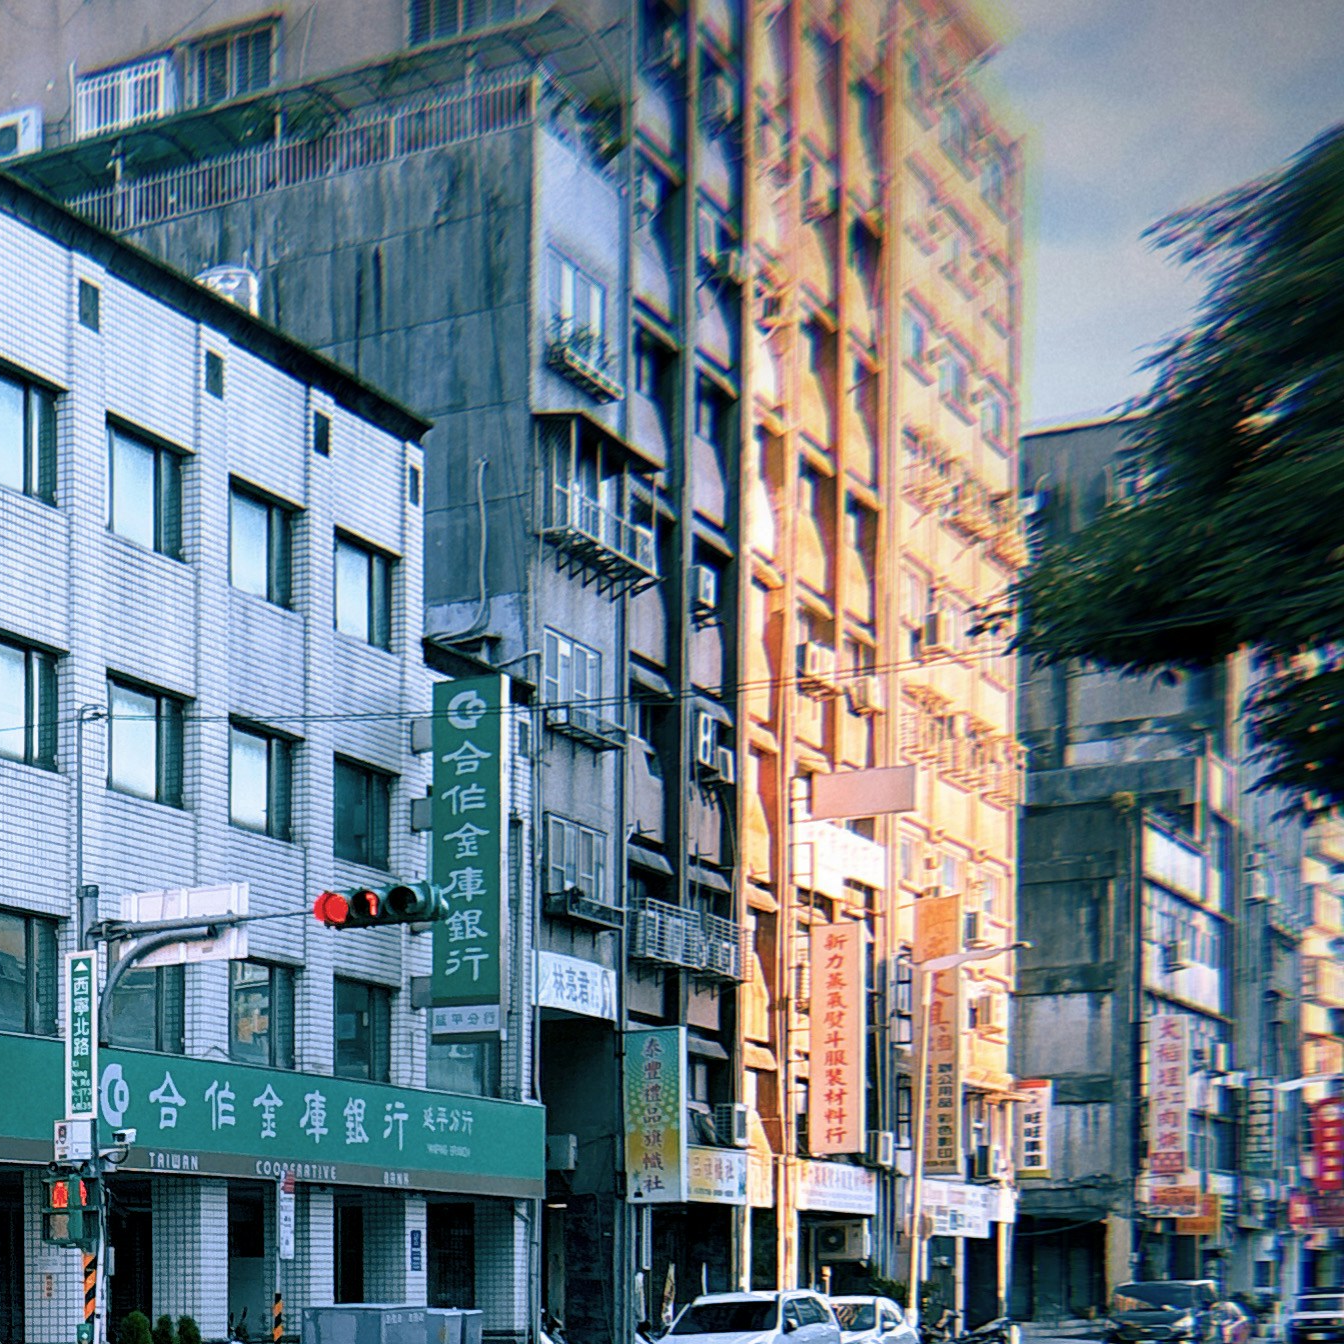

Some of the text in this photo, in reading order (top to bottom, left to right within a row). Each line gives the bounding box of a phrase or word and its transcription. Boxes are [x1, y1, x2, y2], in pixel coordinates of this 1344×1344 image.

[441, 740, 492, 982] 合作金庫銀行
[73, 976, 90, 1056] 西寧北路
[435, 1009, 497, 1026] 延平分行
[149, 1071, 474, 1151] 合作金庫銀行 延平分行
[149, 1151, 199, 1171] TAIWAN
[383, 1171, 411, 1186] BANK
